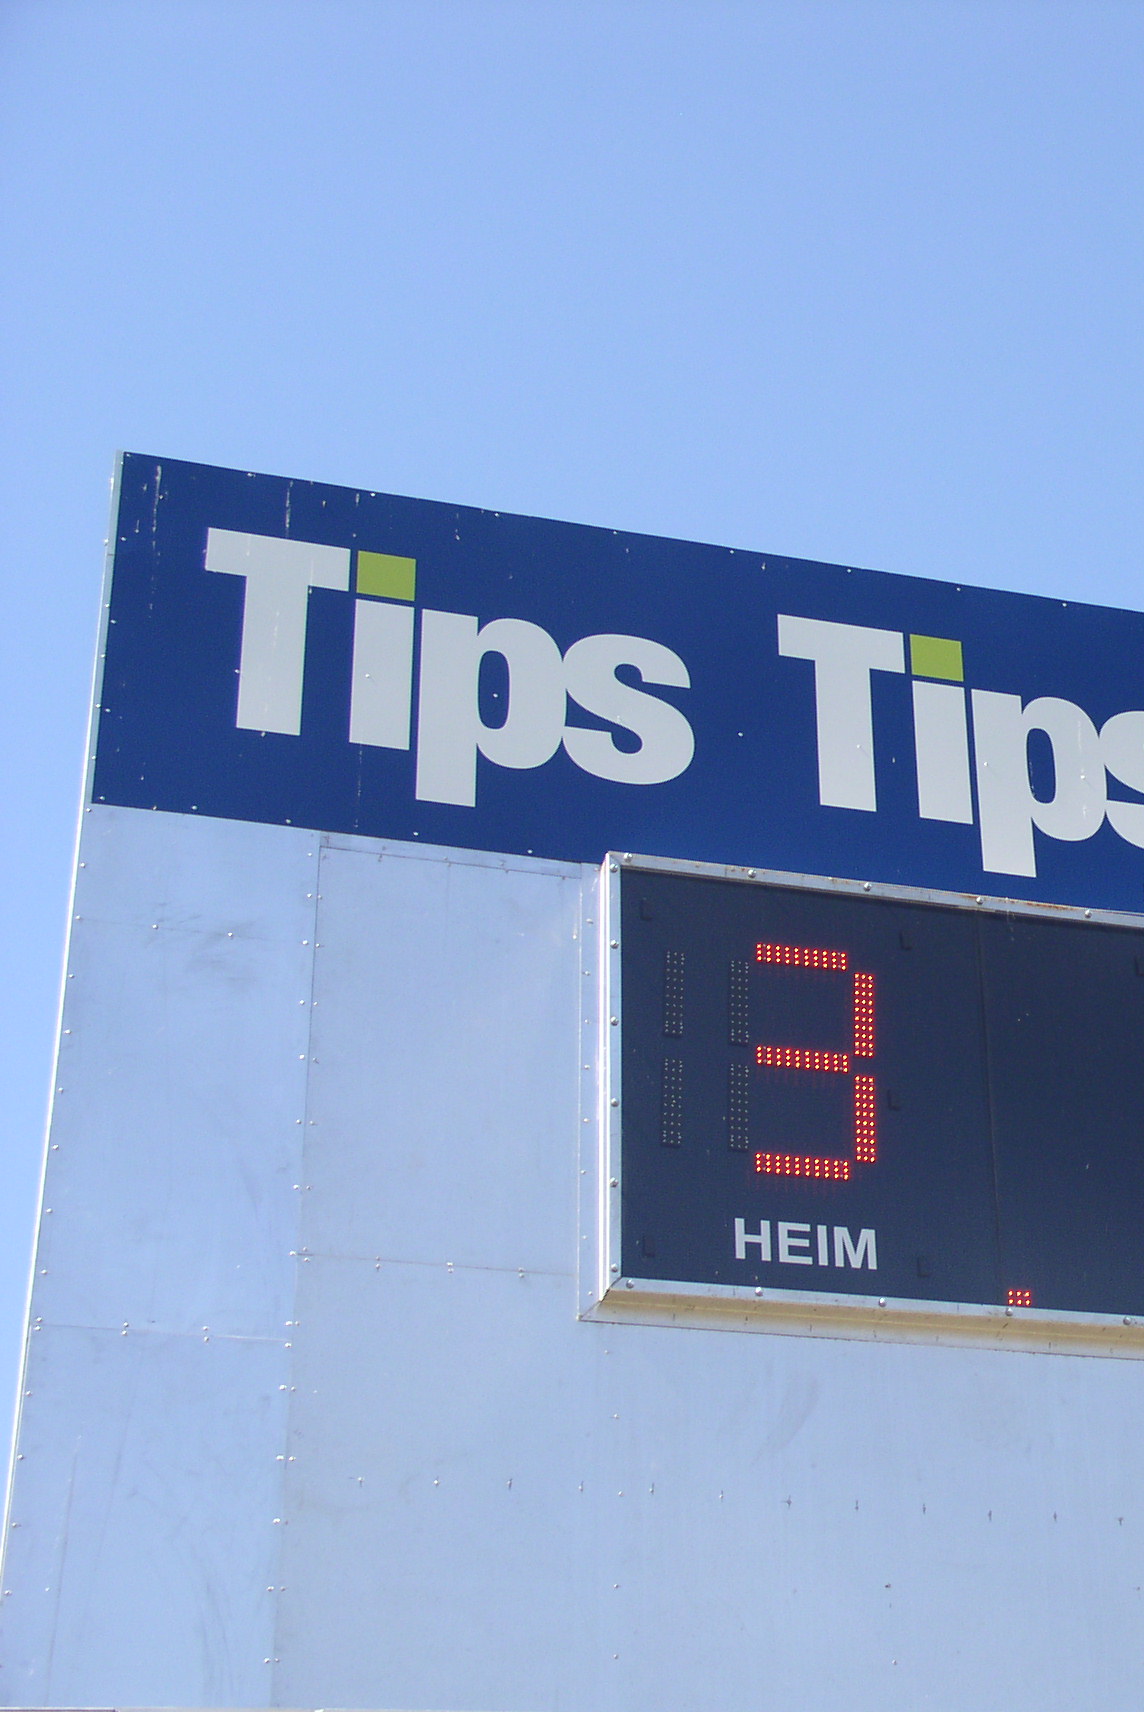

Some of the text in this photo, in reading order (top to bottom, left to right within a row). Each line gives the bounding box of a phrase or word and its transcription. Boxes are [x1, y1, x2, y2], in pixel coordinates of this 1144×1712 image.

[204, 527, 695, 808] Tips
[755, 942, 877, 1181] 3
[734, 1217, 878, 1271] HEIM
